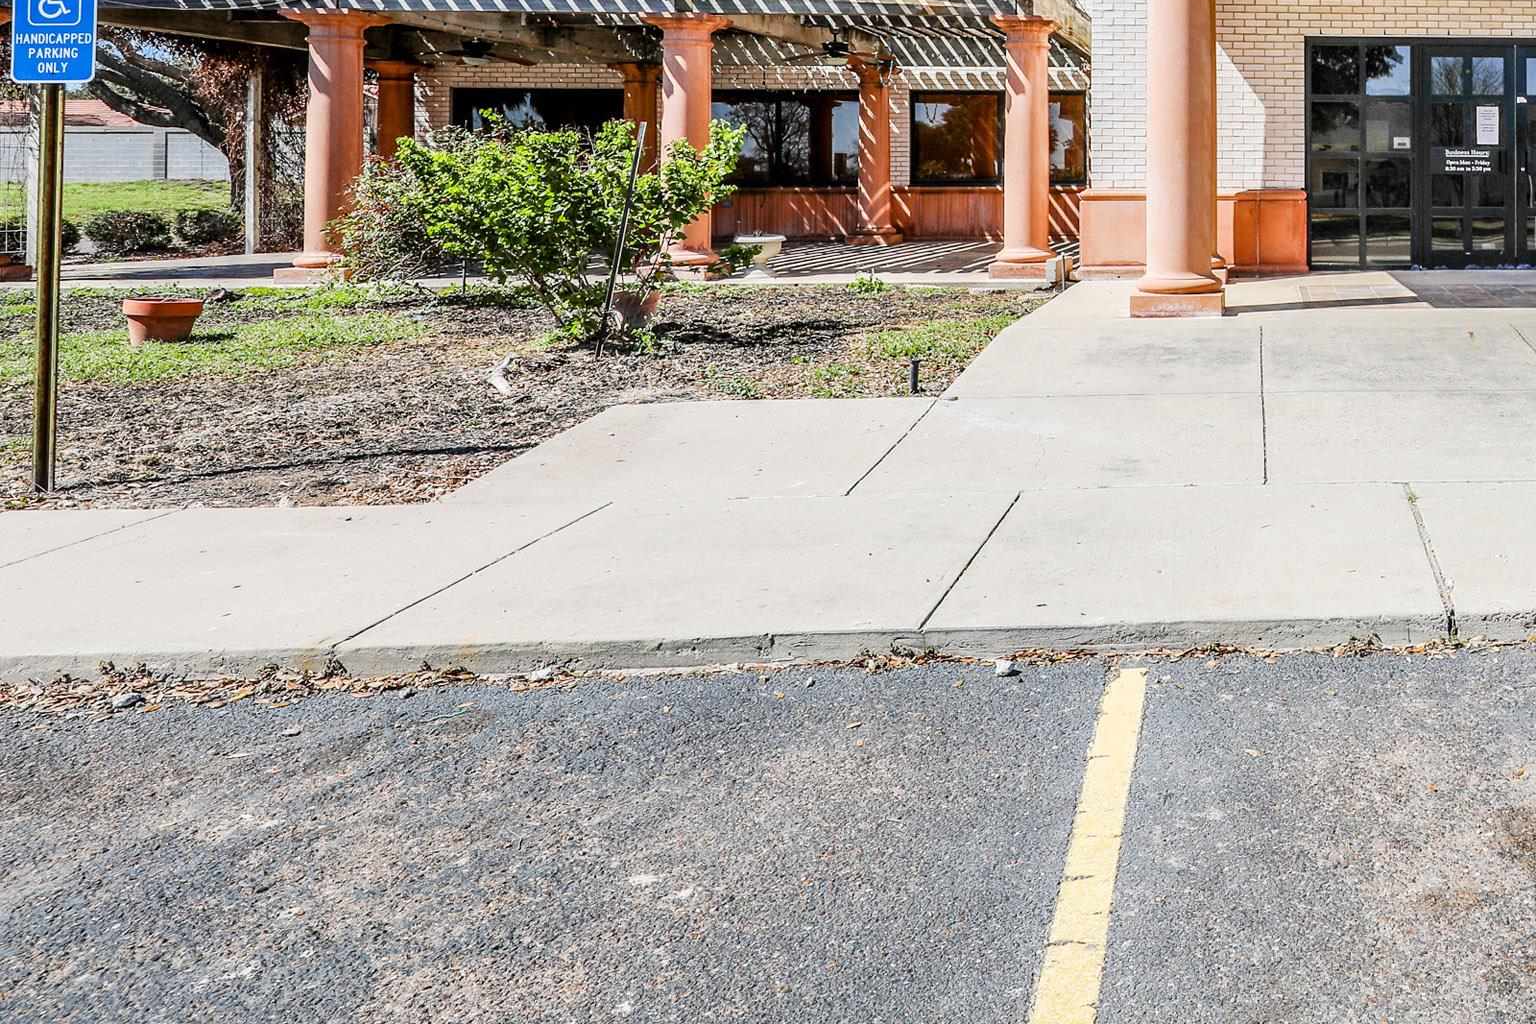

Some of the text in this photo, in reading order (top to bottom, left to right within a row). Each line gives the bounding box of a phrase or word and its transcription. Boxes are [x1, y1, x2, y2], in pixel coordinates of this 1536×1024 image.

[15, 32, 92, 44] HANDICAPPED
[28, 47, 79, 59] PARKING
[37, 62, 69, 73] ONLY
